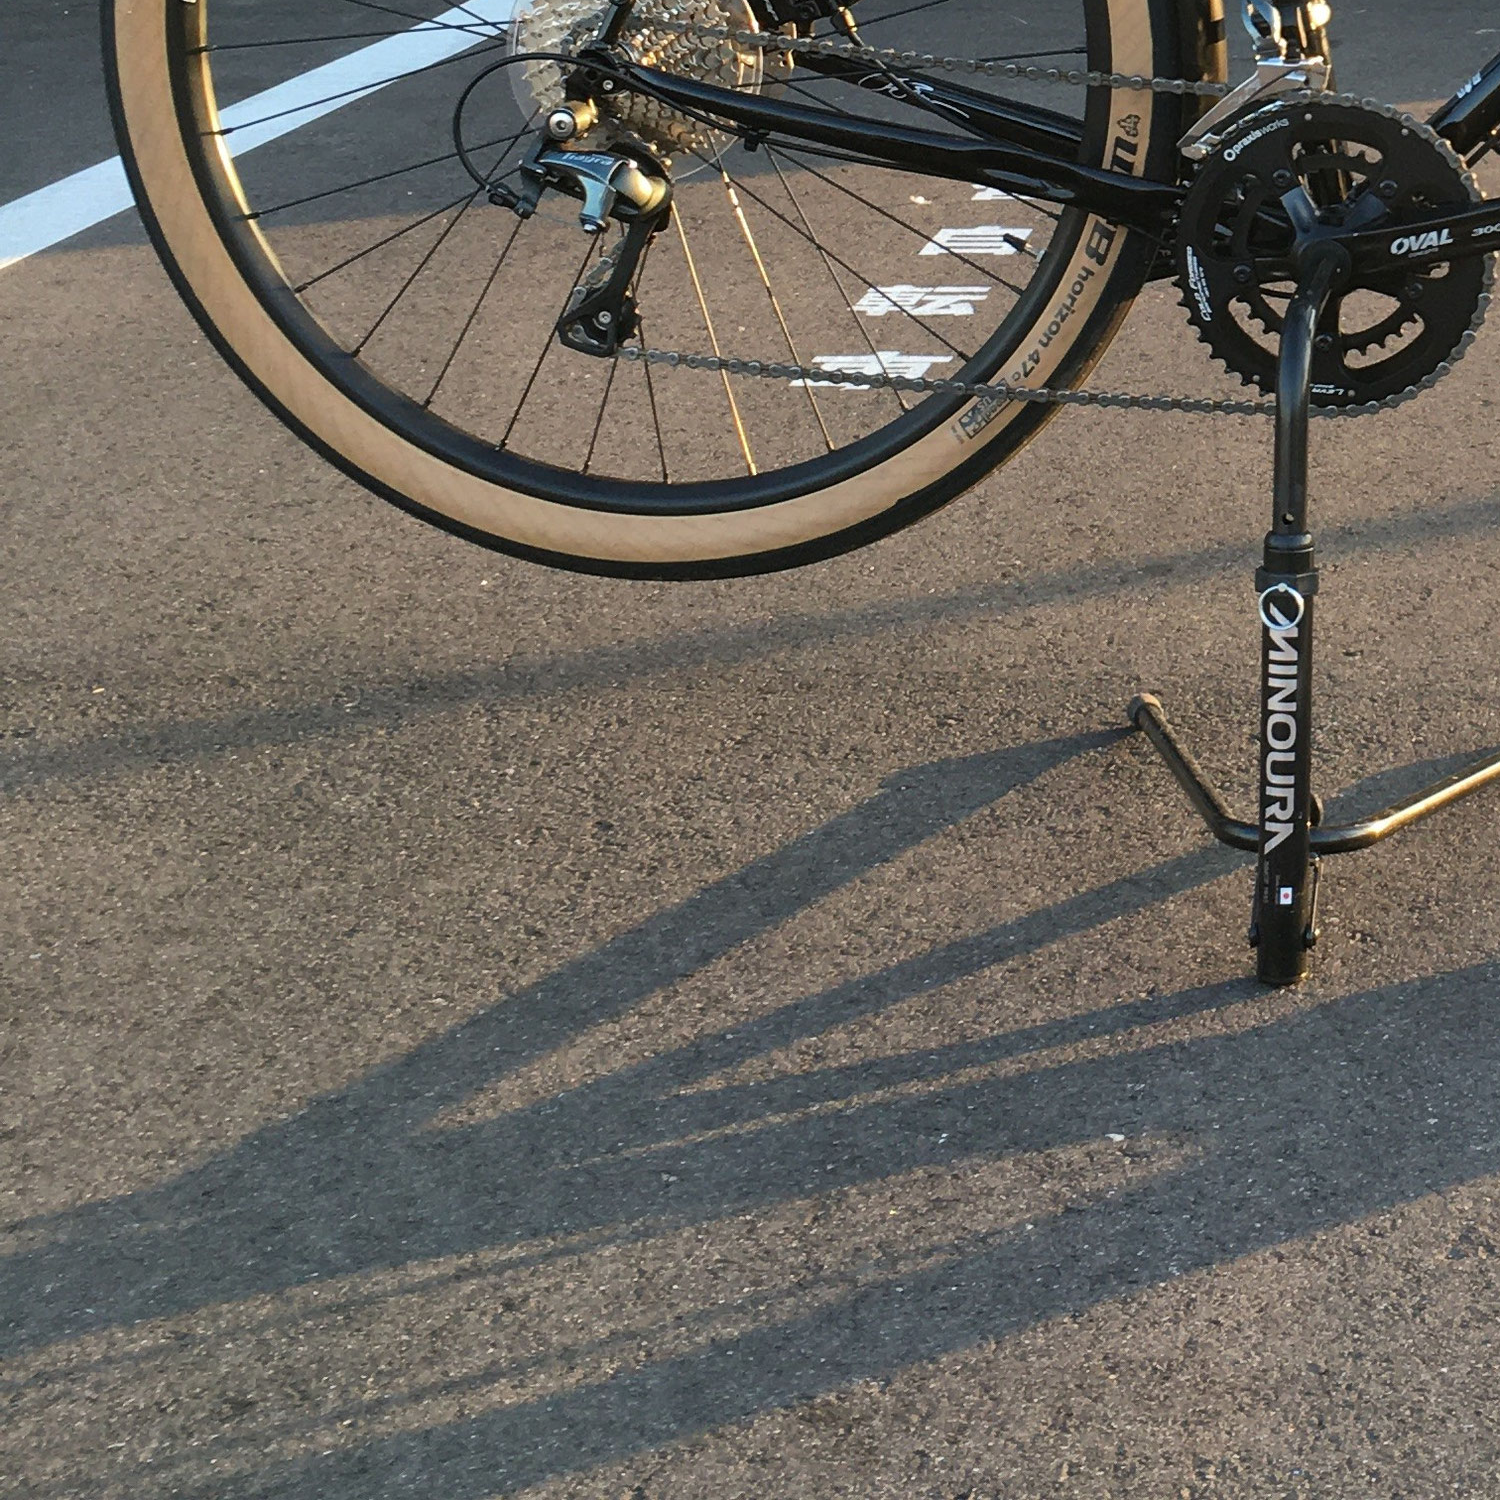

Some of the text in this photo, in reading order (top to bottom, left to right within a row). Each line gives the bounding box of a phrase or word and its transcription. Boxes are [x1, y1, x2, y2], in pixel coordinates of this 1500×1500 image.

[1390, 227, 1454, 256] OVAL
[1039, 266, 1095, 350] horizon
[1264, 602, 1298, 855] MINOURA
